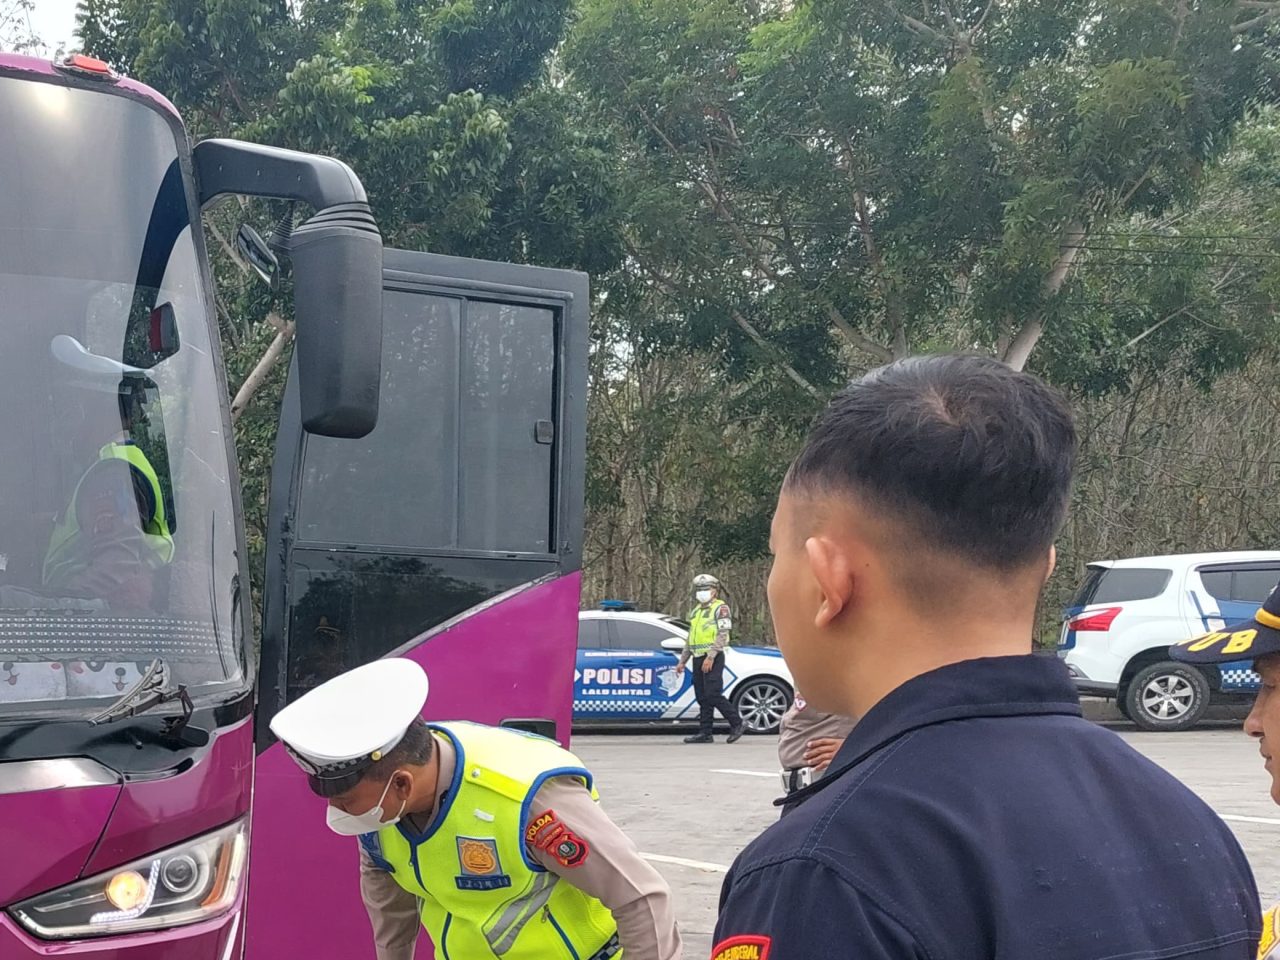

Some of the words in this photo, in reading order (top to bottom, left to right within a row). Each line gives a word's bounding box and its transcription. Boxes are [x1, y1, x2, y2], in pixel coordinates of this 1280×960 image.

[583, 668, 653, 685] POLISI
[611, 688, 651, 696] LINTAS
[526, 814, 553, 841] POLDA
